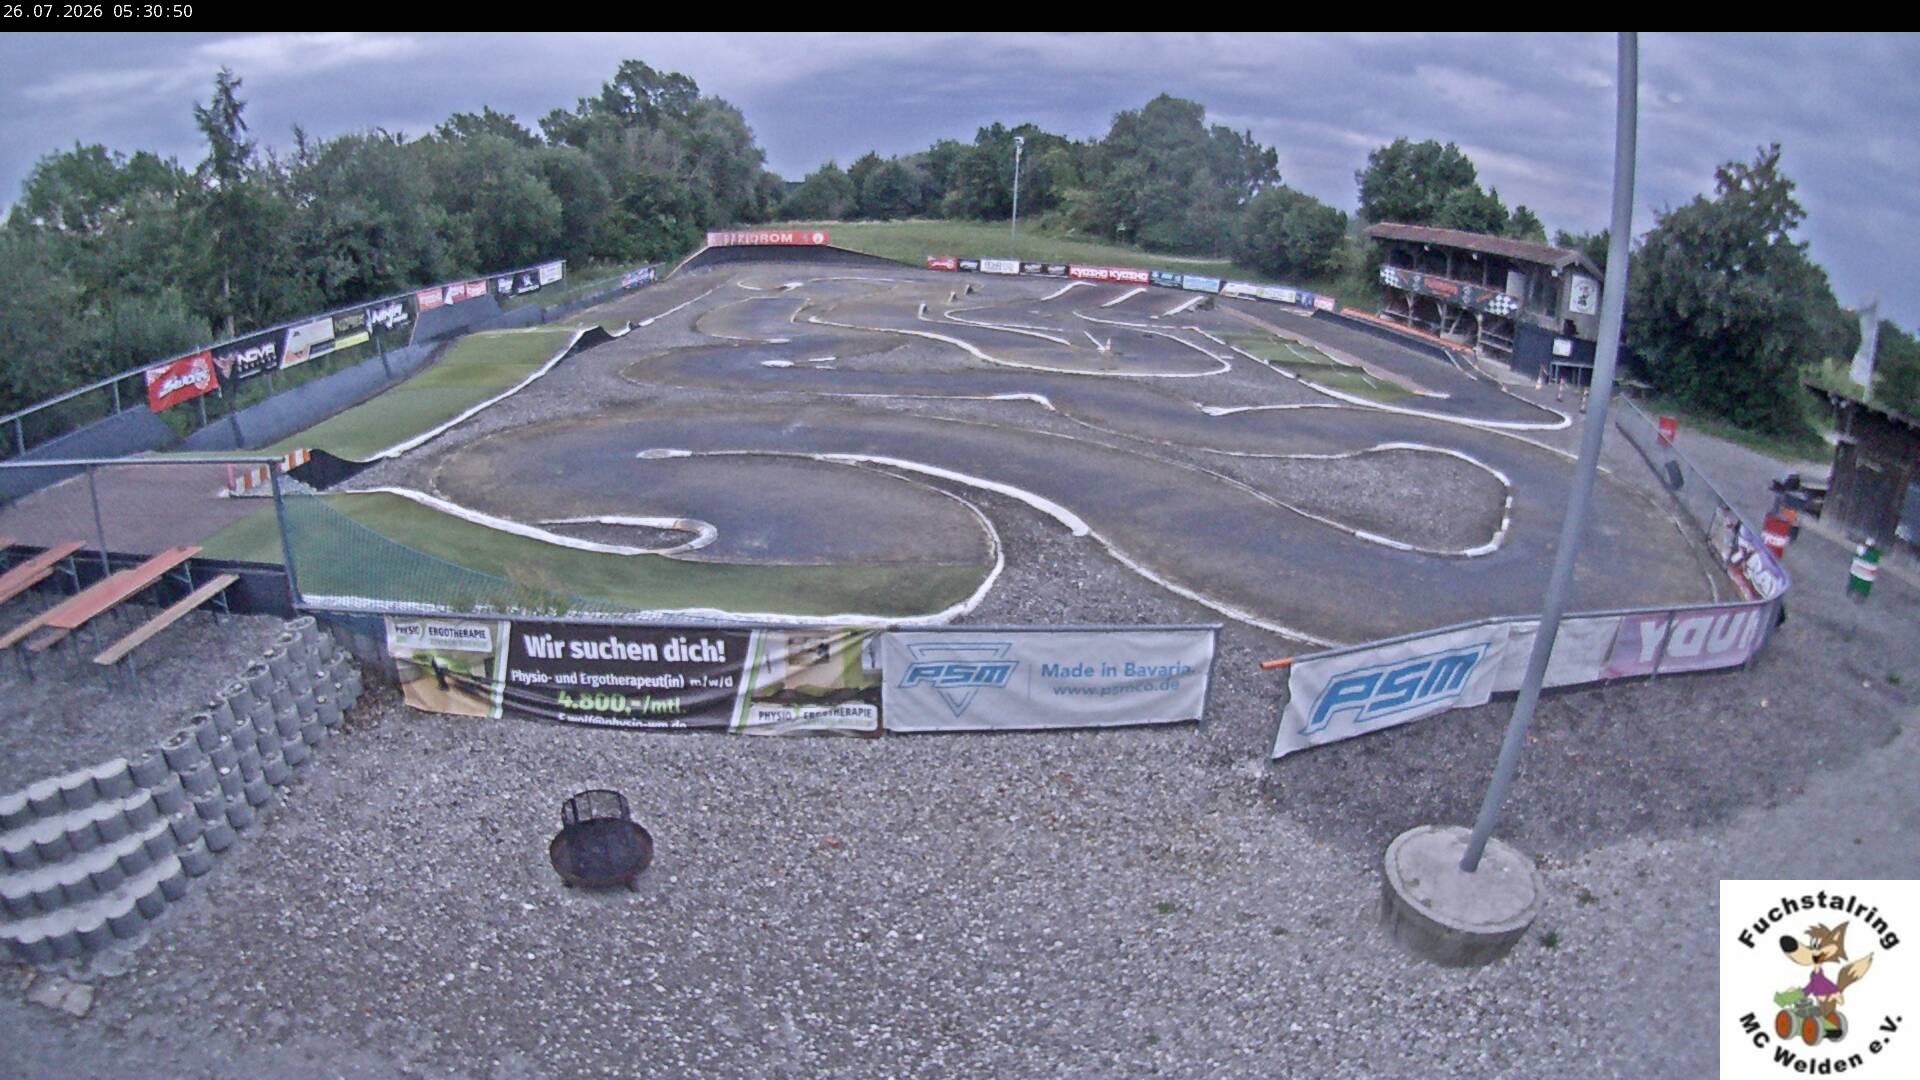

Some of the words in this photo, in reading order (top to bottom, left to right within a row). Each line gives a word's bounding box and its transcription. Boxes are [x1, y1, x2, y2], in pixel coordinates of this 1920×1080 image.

[428, 626, 487, 639] ERGOTHERAPIE
[523, 633, 565, 659] Wir
[569, 636, 658, 662] suchen
[663, 636, 726, 663] dich!
[511, 669, 552, 685] Physio-
[556, 671, 577, 684] und
[580, 671, 685, 690] Ergotherapeut(in)
[902, 662, 1013, 686] PSM
[1041, 661, 1094, 678] Made
[1101, 661, 1117, 677] in
[1124, 660, 1192, 678] Bavaria
[1308, 650, 1482, 727] PSM
